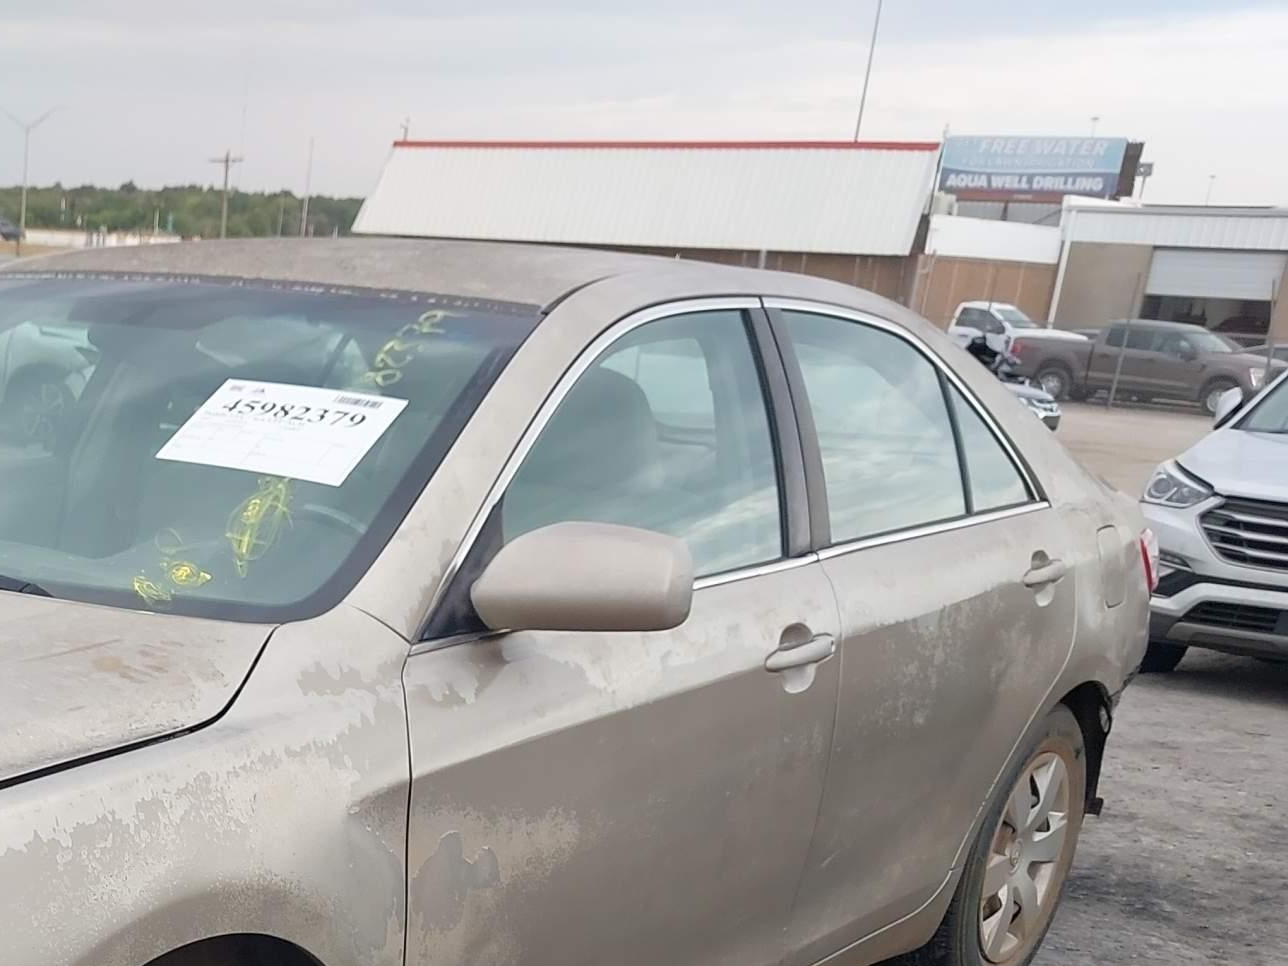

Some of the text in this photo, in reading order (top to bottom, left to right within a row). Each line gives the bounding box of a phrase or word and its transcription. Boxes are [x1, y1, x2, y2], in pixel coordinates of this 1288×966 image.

[978, 138, 1110, 156] FREE WATER
[946, 173, 1104, 191] AQUA WELL DRILLING
[222, 398, 367, 428] 45982379
